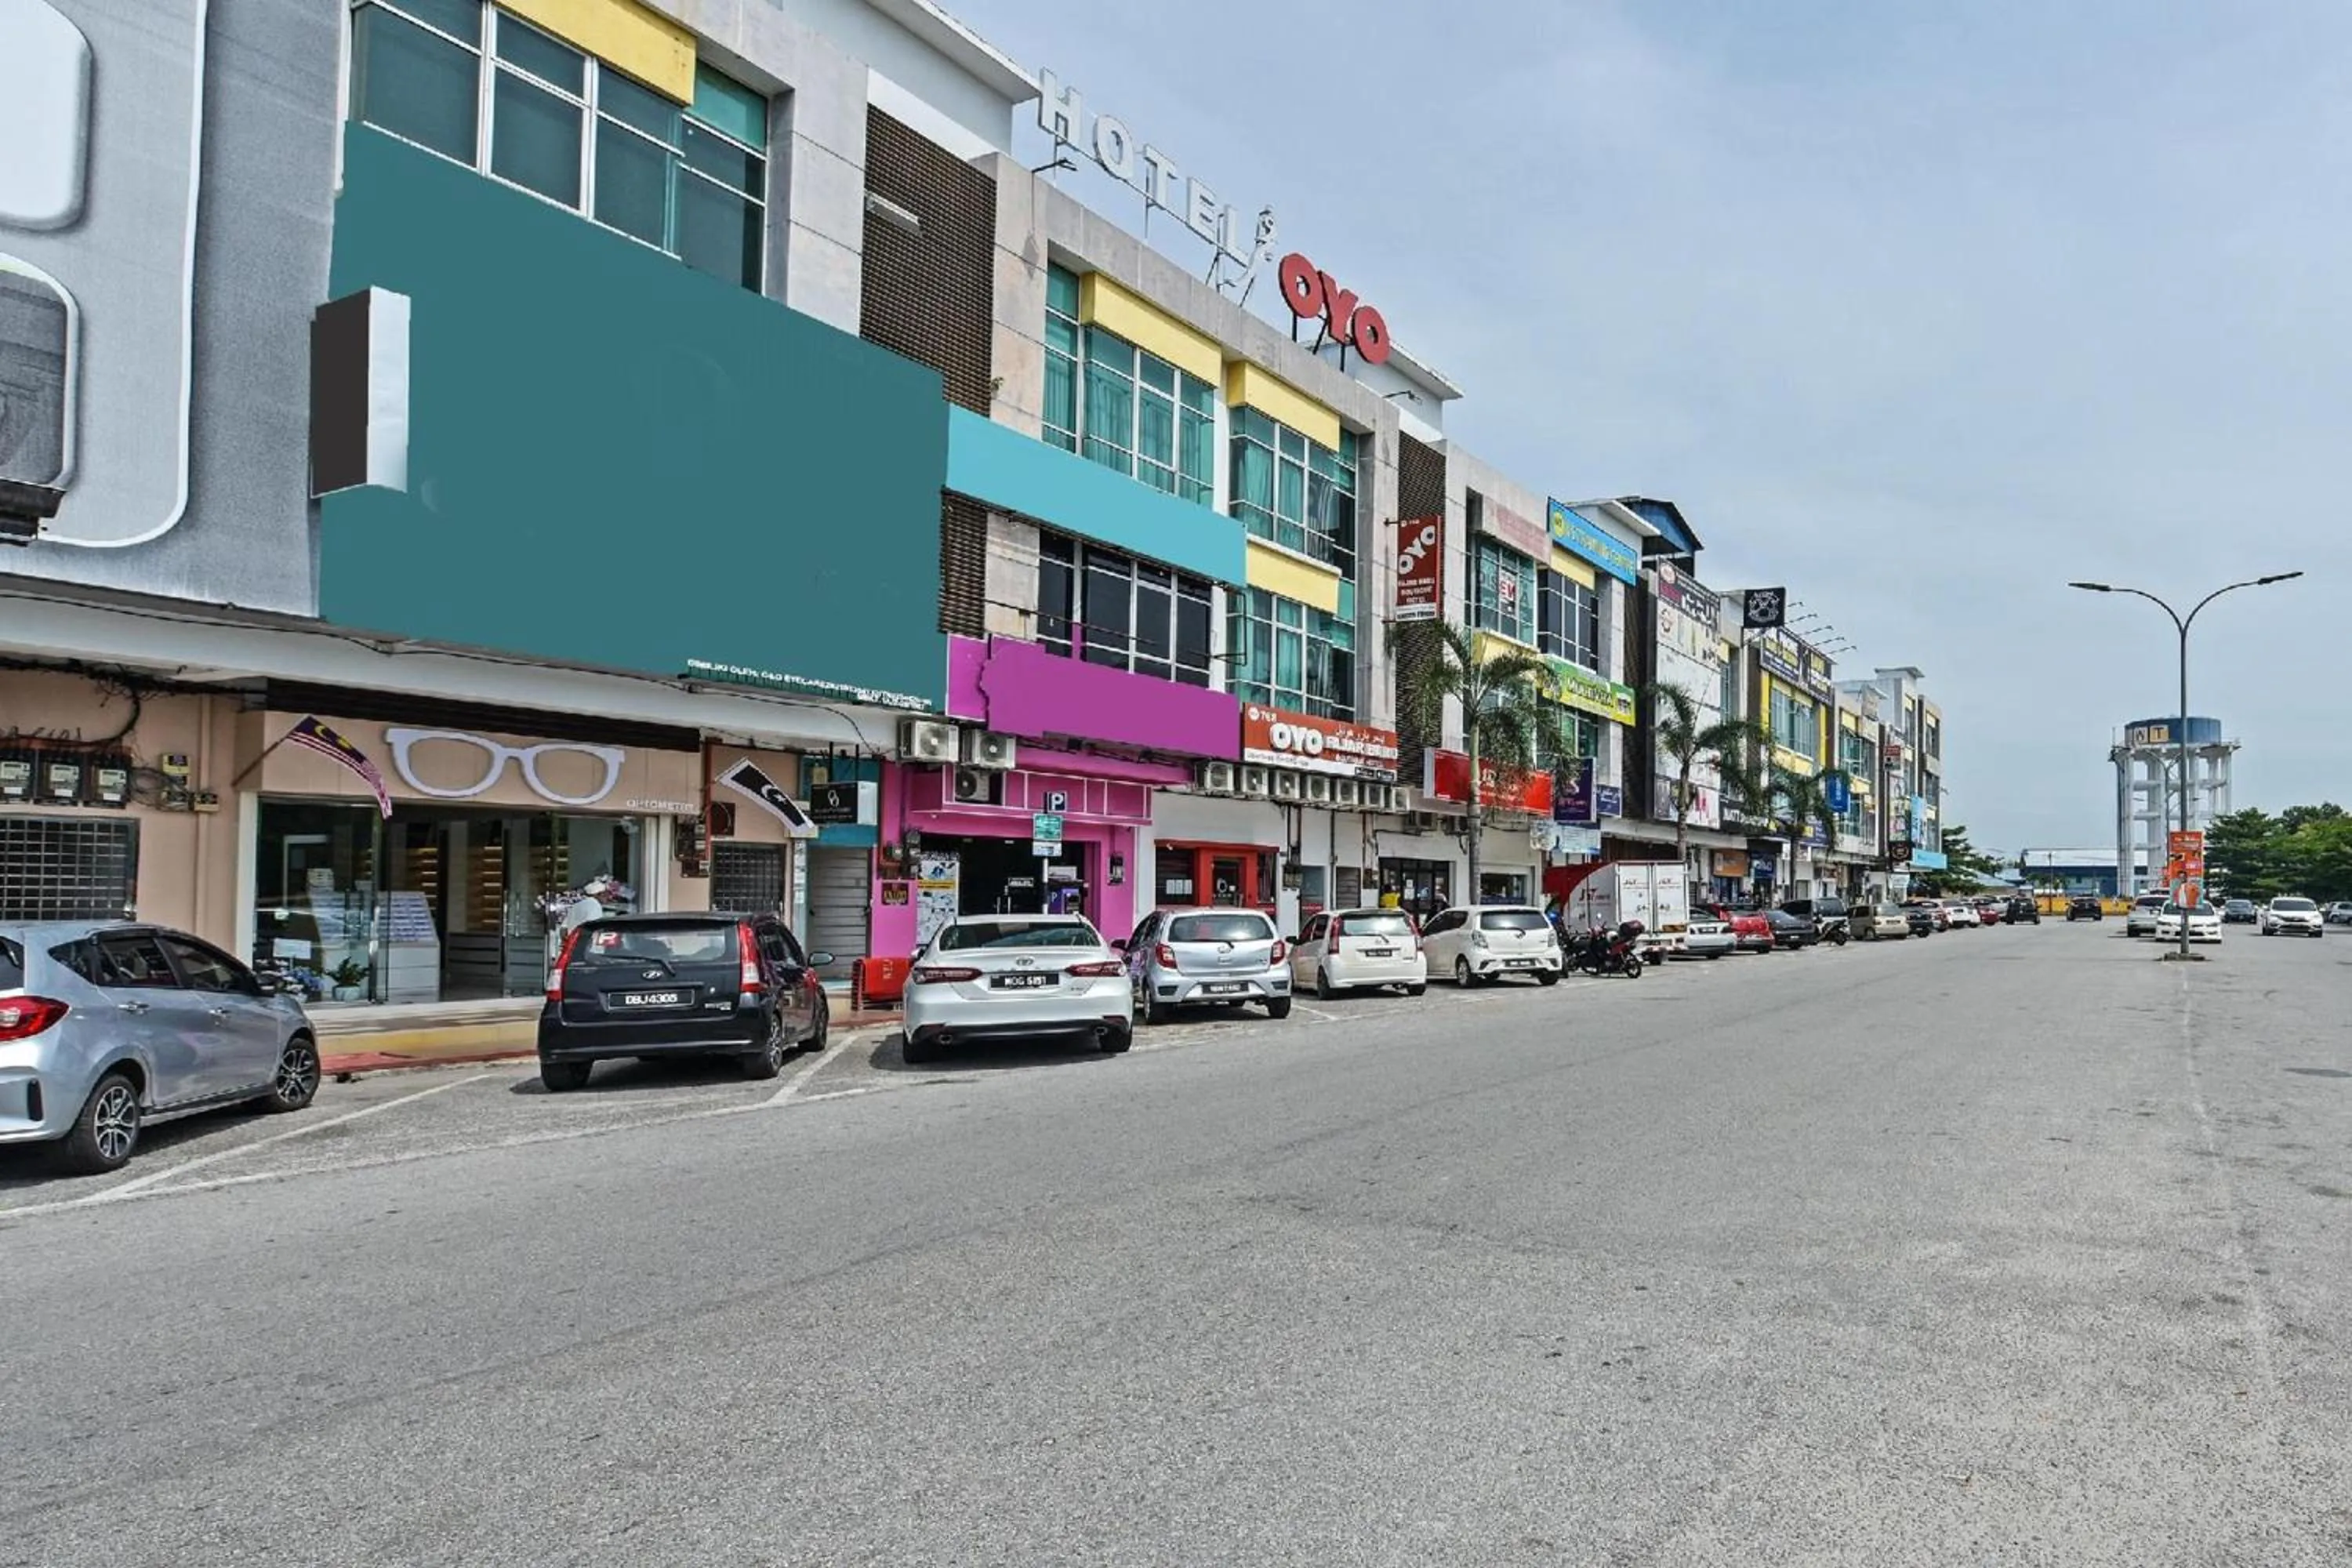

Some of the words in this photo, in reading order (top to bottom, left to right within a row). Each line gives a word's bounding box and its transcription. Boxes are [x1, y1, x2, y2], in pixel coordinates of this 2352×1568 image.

[1038, 67, 1255, 267] HOTEL
[1279, 252, 1390, 365] OYO
[1399, 524, 1436, 575] OYO
[1270, 723, 1324, 755] OYO
[1051, 793, 1064, 811] P
